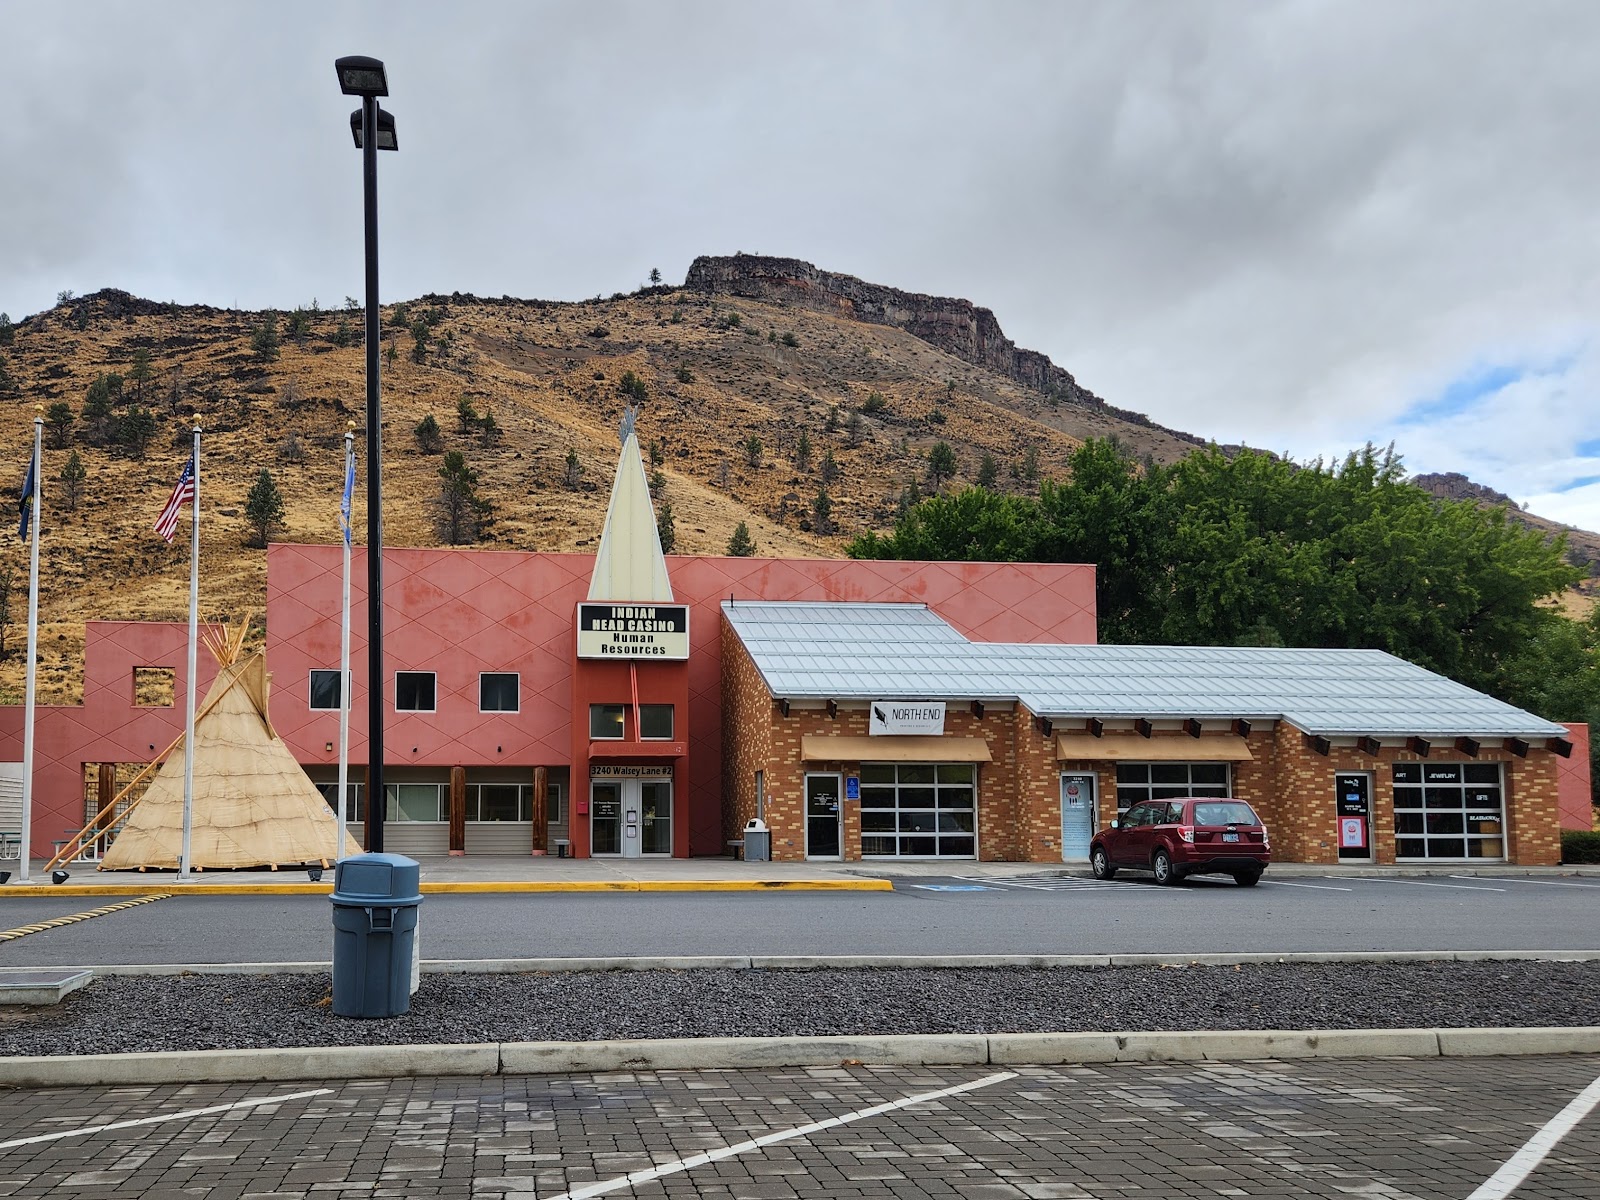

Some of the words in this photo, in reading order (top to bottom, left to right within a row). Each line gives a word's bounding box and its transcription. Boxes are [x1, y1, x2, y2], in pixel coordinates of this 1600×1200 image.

[611, 607, 656, 619] INDIAN
[592, 619, 625, 630] HEAD
[627, 620, 675, 632] CASINO
[613, 633, 654, 643] Human
[601, 644, 666, 655] Resources
[892, 708, 922, 720] NORTH
[922, 708, 941, 720] END
[591, 766, 611, 775] 3240
[613, 767, 640, 776] Walsey
[641, 767, 660, 775] Lane
[662, 767, 672, 775] #2
